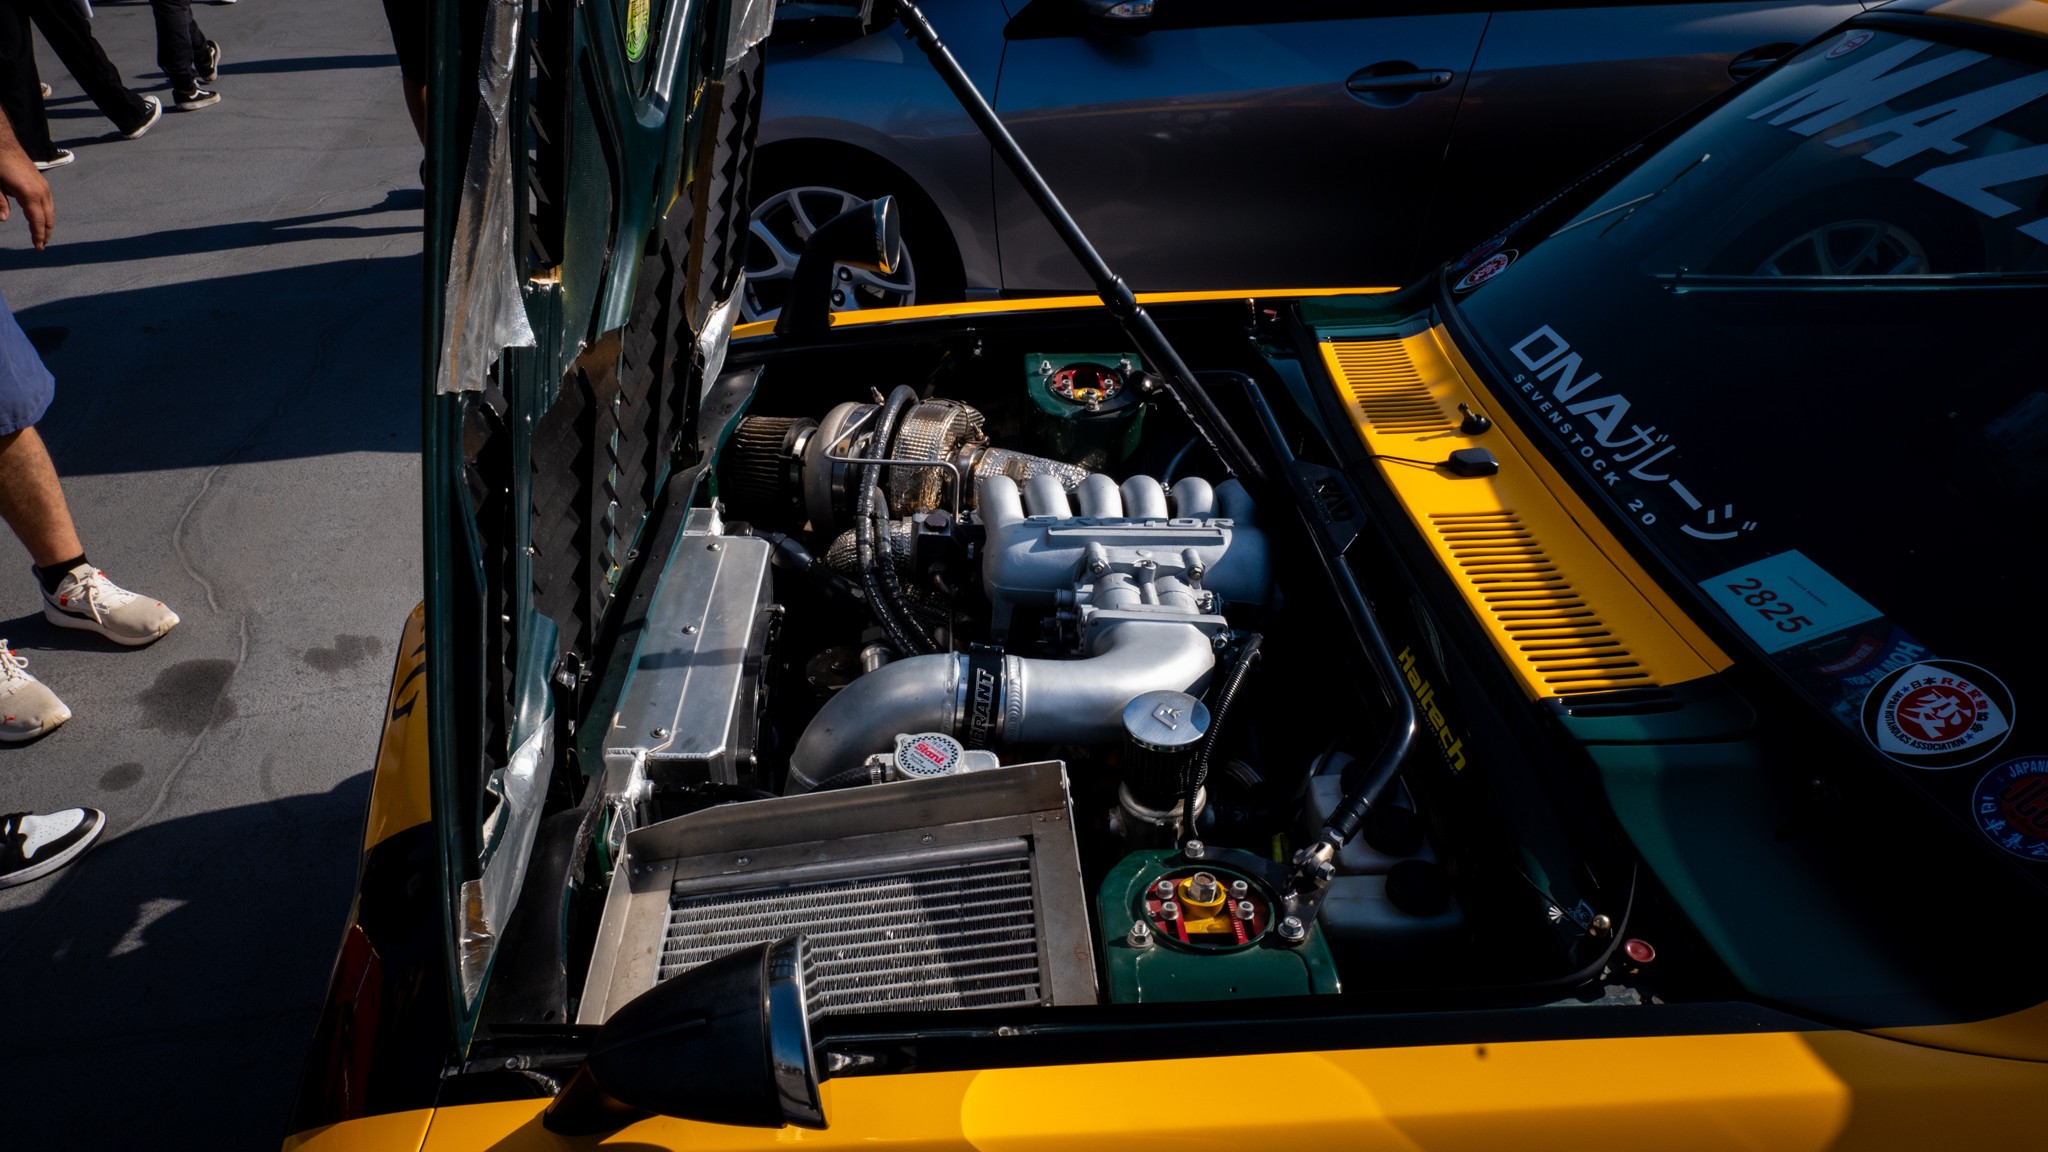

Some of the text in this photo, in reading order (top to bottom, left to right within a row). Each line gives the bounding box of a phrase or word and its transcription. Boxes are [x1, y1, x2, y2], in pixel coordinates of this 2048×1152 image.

[1746, 38, 2048, 247] MAZ
[1513, 373, 1657, 526] SEVENSTOCK 20
[1726, 577, 1814, 634] 2825
[1397, 645, 1467, 772] Haltech
[1884, 689, 1905, 711] JAPAN
[1908, 736, 1967, 752] ASSOCIATION
